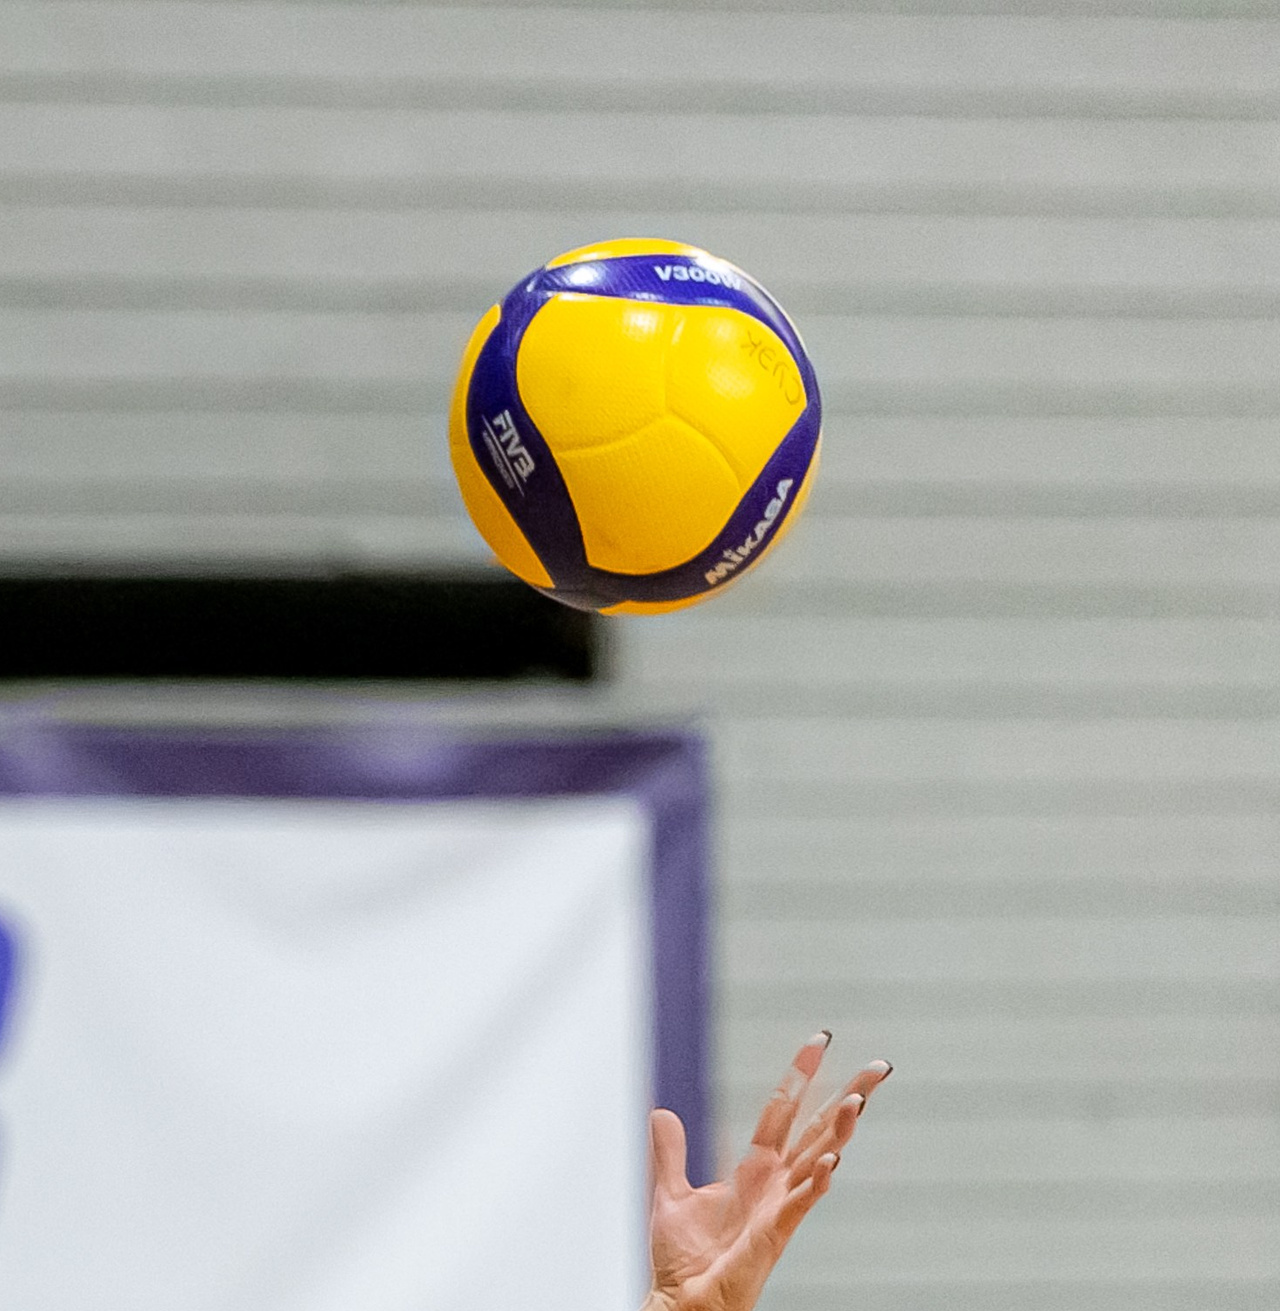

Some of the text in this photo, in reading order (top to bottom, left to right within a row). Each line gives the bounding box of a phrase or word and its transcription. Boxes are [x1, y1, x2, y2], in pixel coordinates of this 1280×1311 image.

[653, 264, 741, 291] V300W
[491, 409, 535, 483] FIVB
[704, 478, 794, 586] MIKASA
